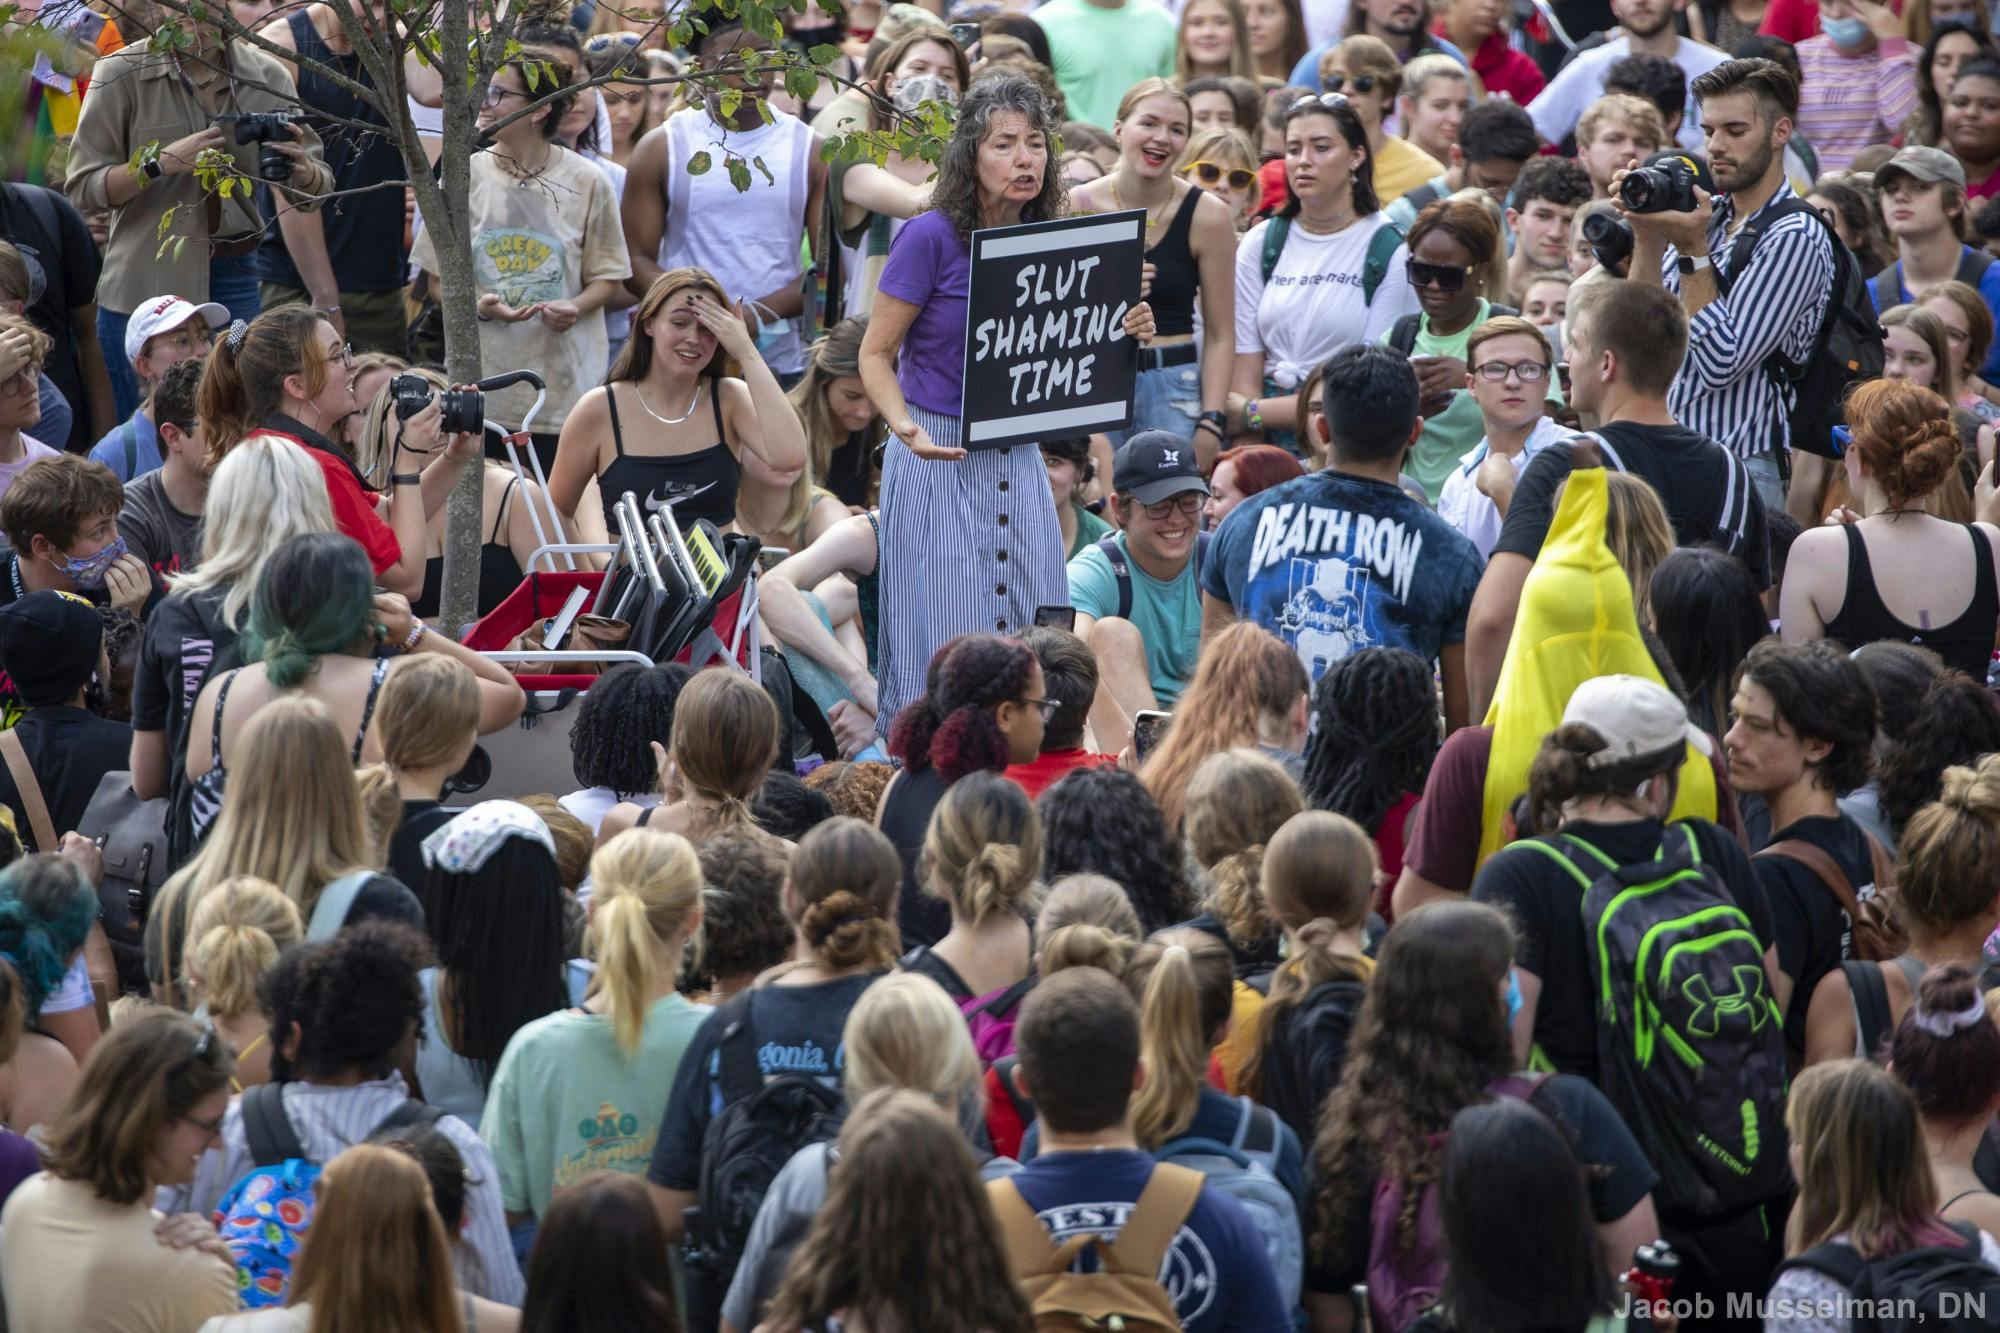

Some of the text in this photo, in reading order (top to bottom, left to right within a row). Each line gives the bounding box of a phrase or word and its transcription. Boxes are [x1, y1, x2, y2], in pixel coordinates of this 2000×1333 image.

[485, 234, 553, 261] GREEN
[495, 253, 541, 273] DAY
[1016, 255, 1100, 308] SLUT
[1299, 275, 1322, 286] are
[1322, 272, 1365, 287] marte
[975, 300, 1128, 362] SHAMING
[1009, 353, 1096, 406] TIME
[1247, 502, 1423, 607] DEATH ROW
